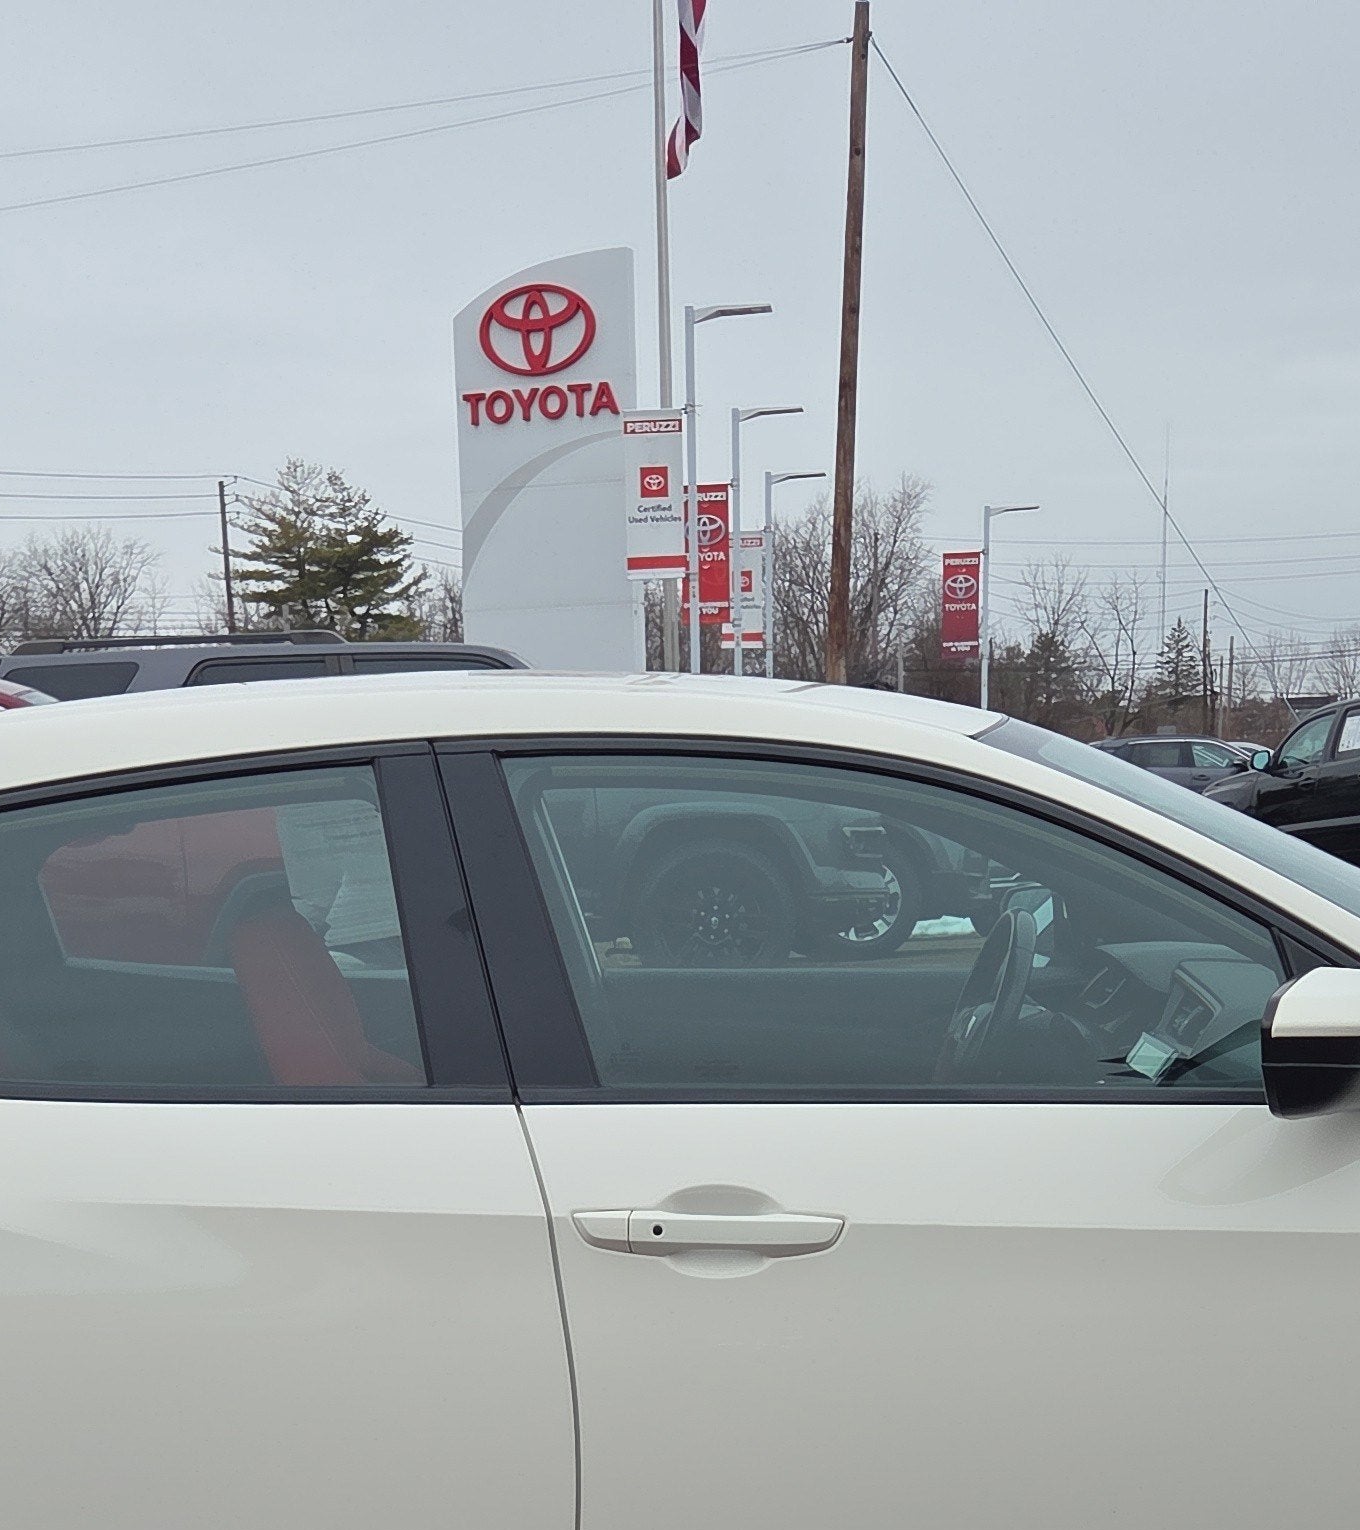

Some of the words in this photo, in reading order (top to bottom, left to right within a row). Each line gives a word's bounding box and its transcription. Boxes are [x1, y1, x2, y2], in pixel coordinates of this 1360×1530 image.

[462, 382, 620, 426] TOYOTA
[626, 421, 679, 433] PERUZZI
[637, 504, 673, 514] Certified
[628, 515, 649, 524] Used
[649, 515, 682, 524] Vehicles
[686, 551, 726, 562] TYOTA
[945, 603, 977, 612] TOYOTA
